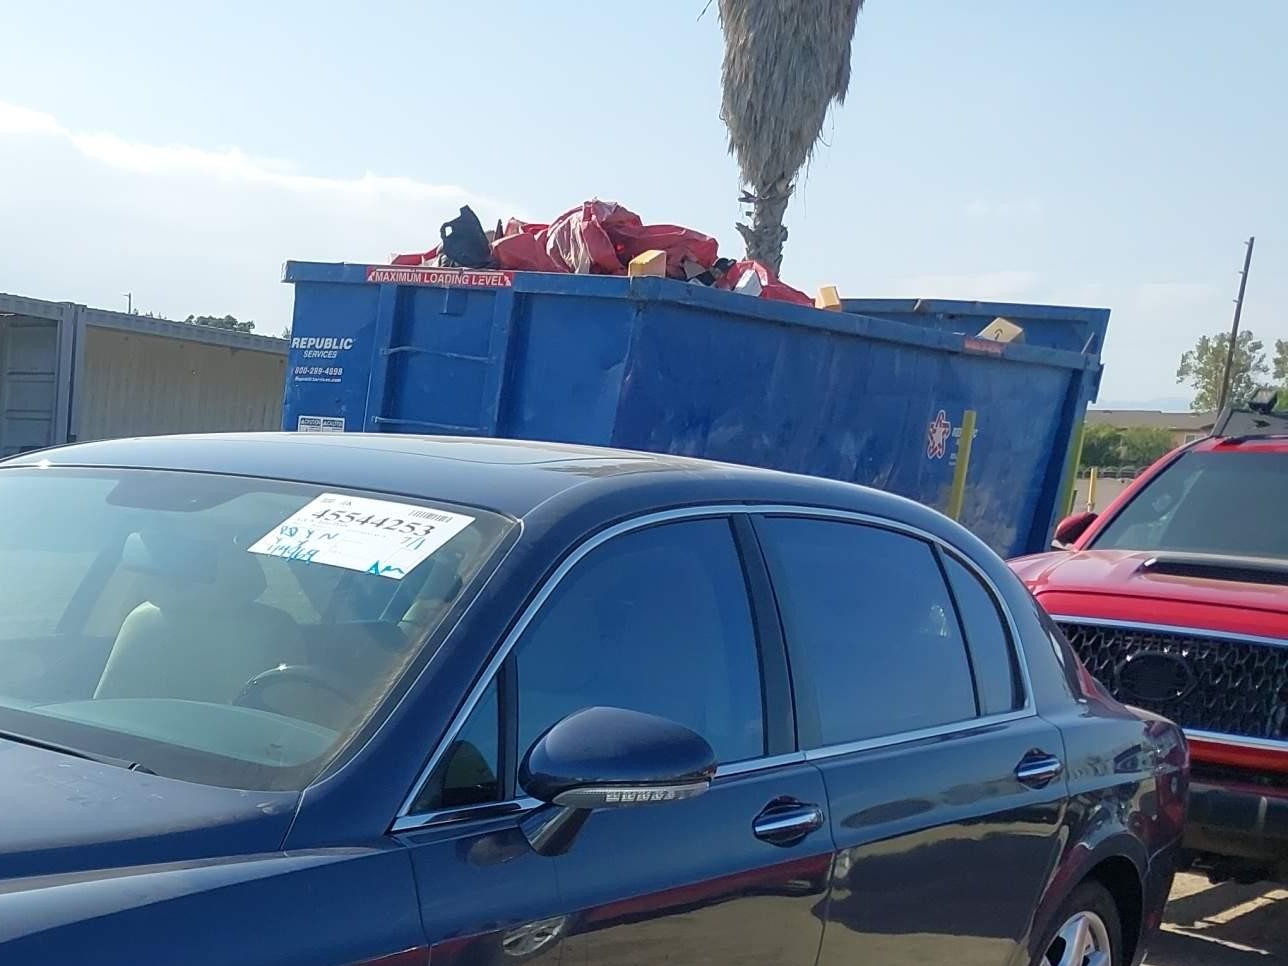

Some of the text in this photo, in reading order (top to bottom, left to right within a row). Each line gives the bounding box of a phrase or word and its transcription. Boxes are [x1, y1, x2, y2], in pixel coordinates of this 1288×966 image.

[375, 271, 505, 286] MAXIMUM LOADING LEVEL
[291, 337, 353, 350] REPUBLIC
[303, 350, 338, 359] SERVICES
[311, 508, 436, 537] 45544253
